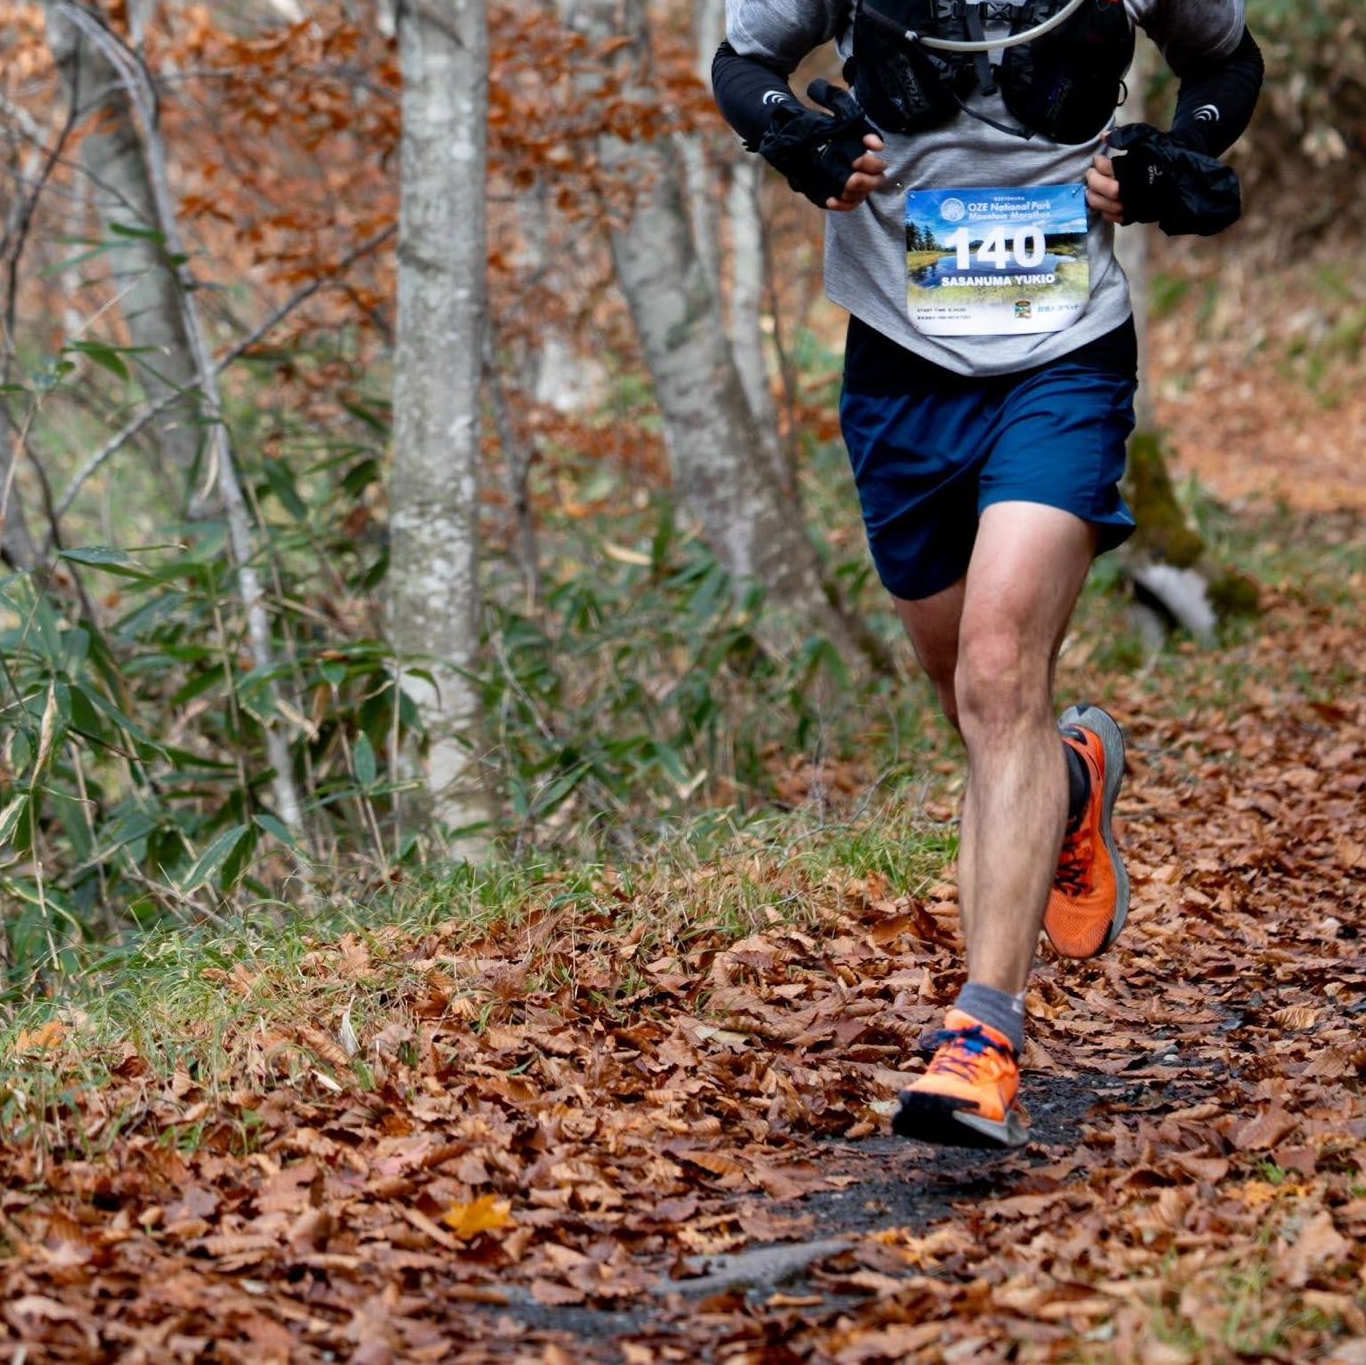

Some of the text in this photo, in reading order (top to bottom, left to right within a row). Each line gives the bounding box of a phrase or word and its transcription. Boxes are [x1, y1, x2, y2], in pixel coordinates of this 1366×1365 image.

[968, 201, 1052, 212] OZE National Park
[969, 210, 1051, 220] Mountain Marathon
[944, 225, 1046, 270] 140
[942, 273, 1056, 286] SASANUMA YUKIO
